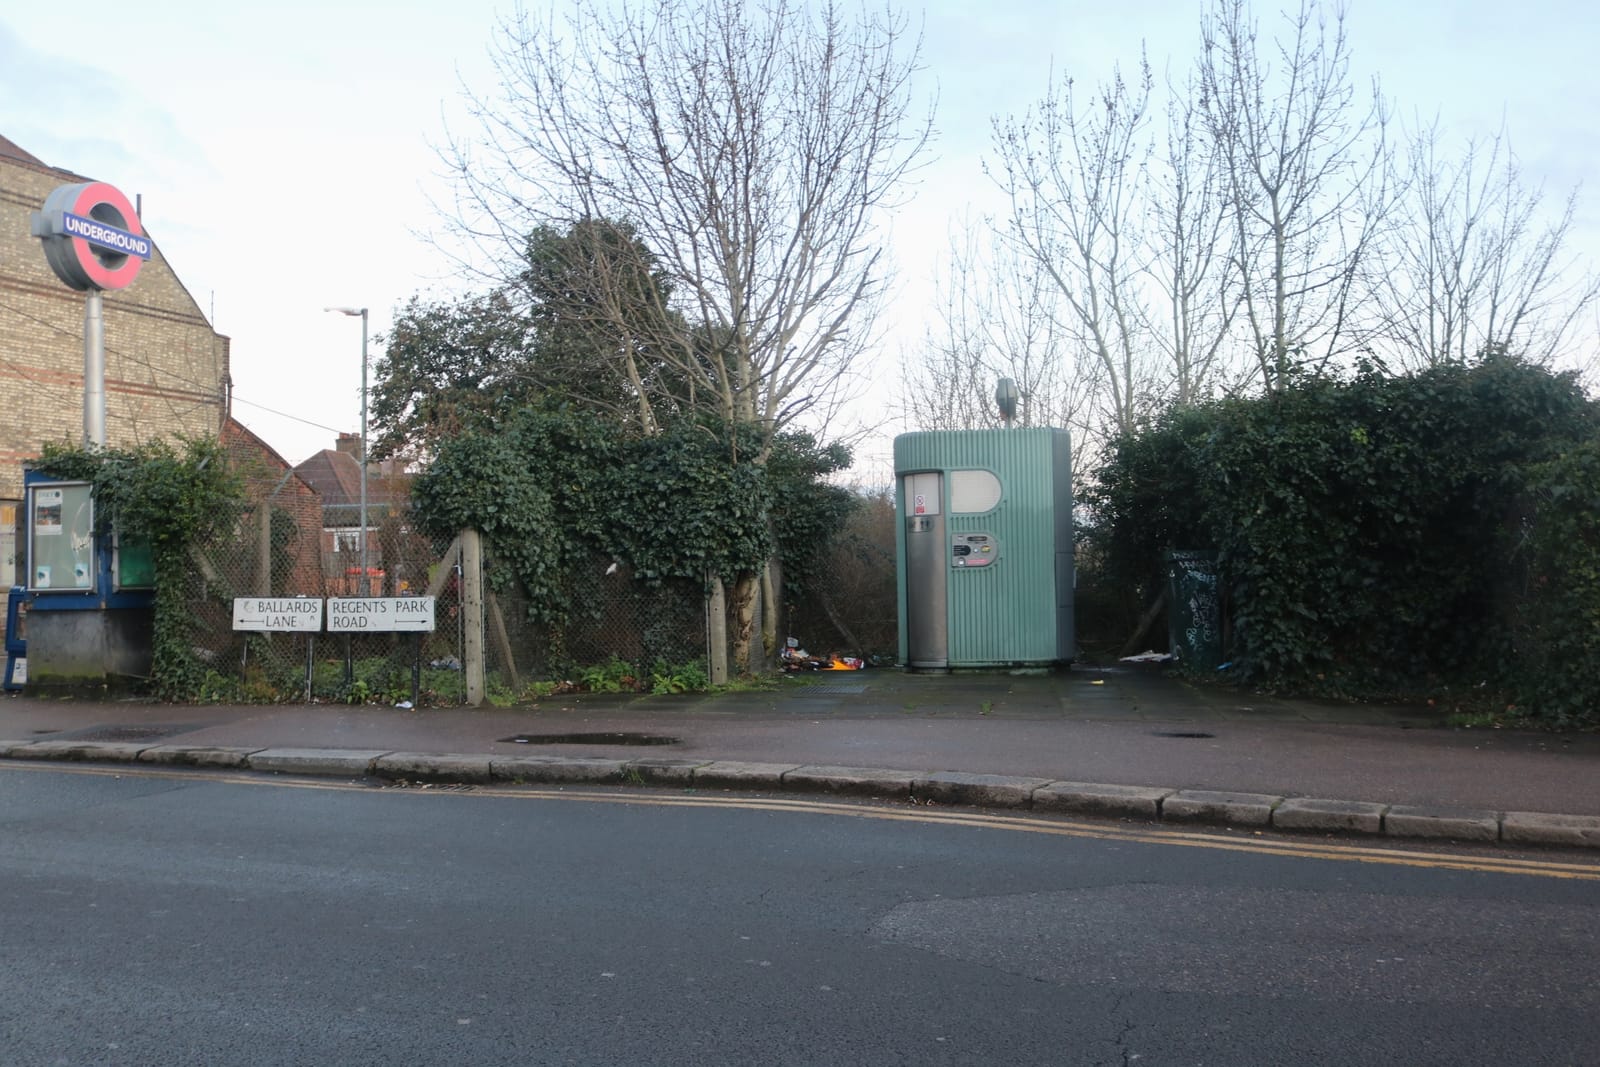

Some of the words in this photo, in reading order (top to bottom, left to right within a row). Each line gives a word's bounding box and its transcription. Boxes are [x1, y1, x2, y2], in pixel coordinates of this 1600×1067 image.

[66, 217, 148, 254] UNDERGROUND
[258, 601, 318, 613] BALLARDS
[332, 601, 387, 613] REGENTS
[395, 600, 428, 613] PARK
[266, 616, 297, 628] LANE
[333, 616, 368, 628] ROAD
